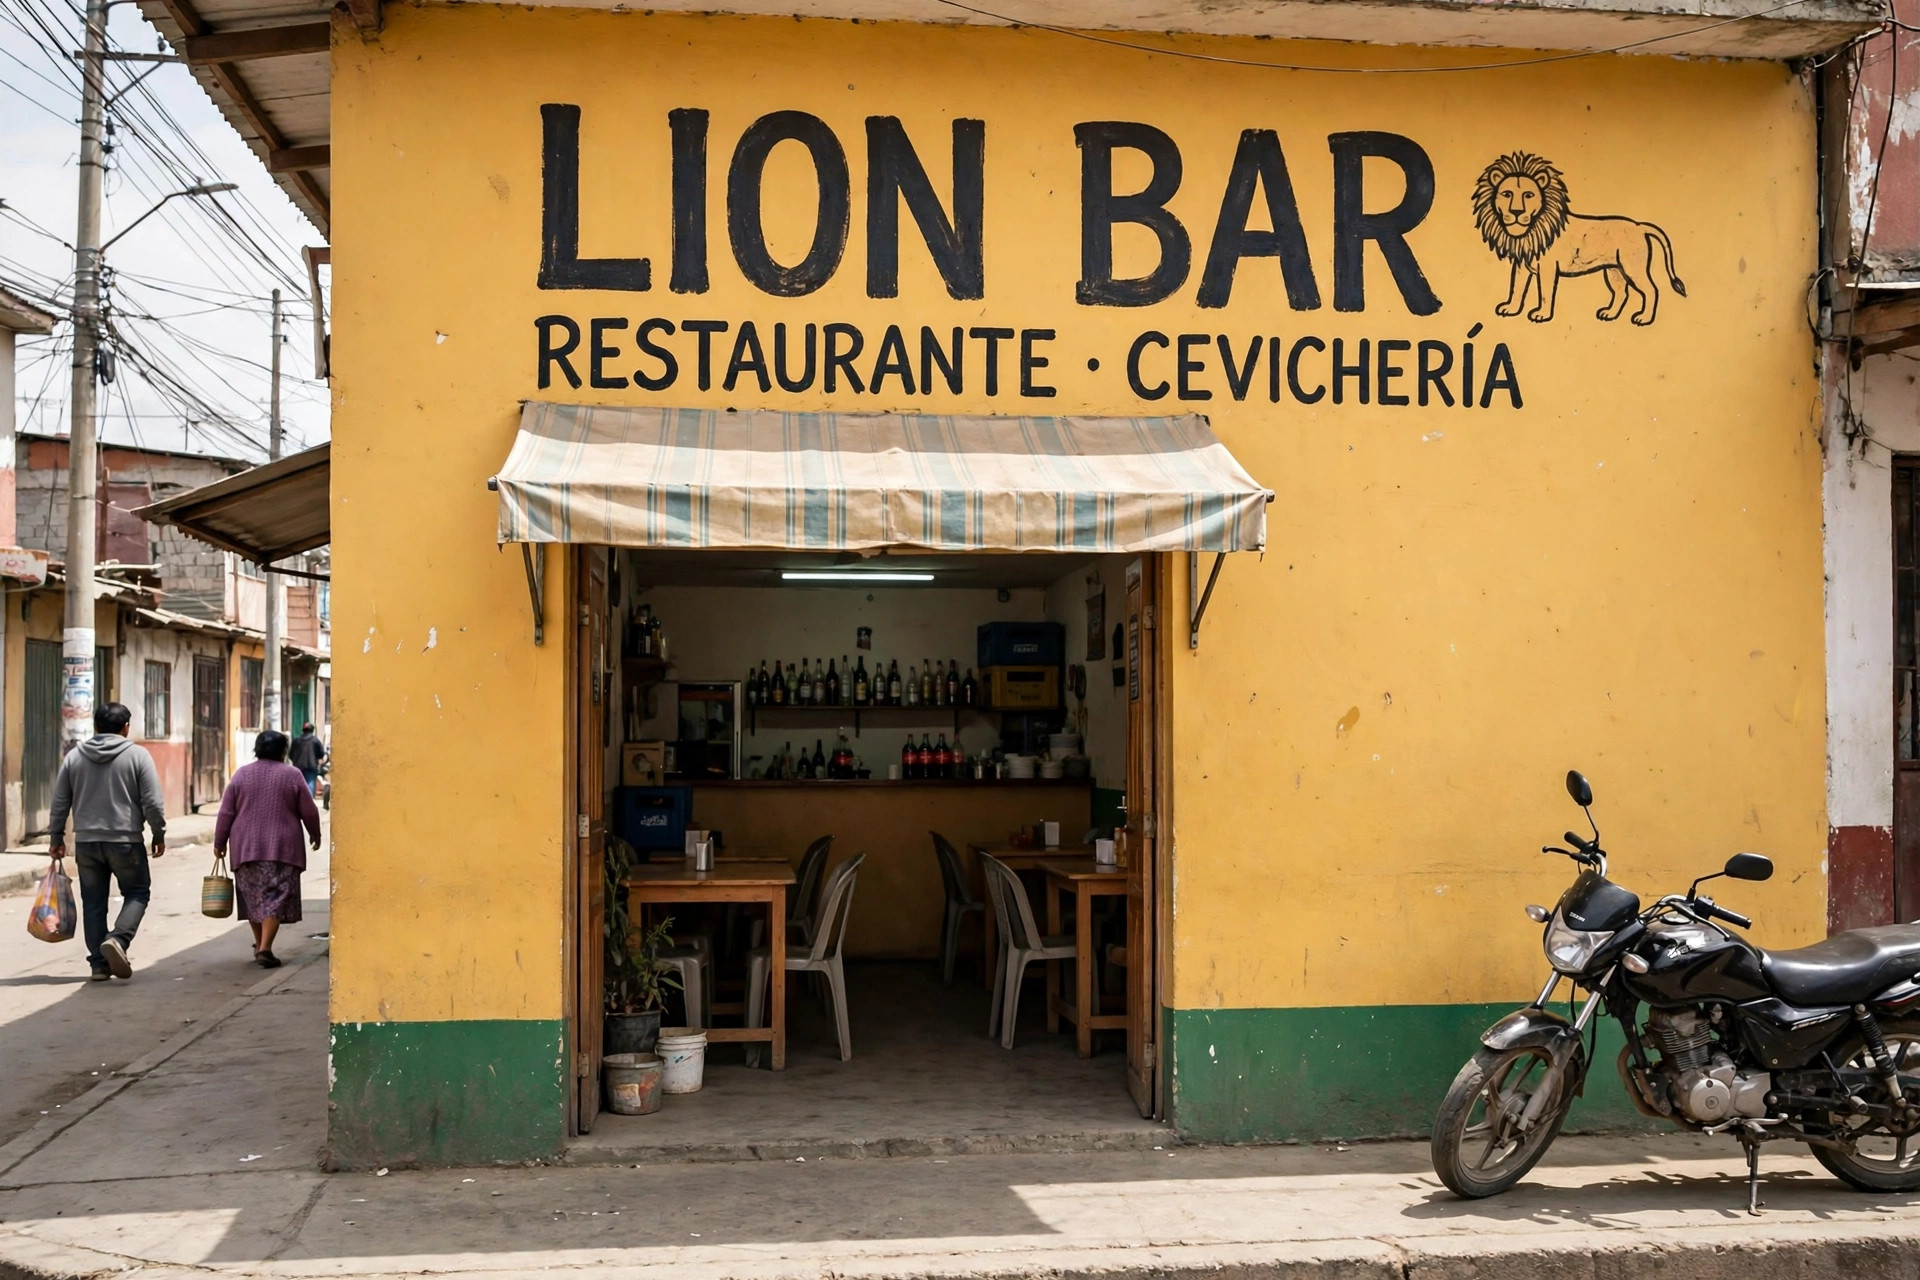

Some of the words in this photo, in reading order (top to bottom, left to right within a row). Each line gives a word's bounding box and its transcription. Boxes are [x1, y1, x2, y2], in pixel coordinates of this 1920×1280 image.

[537, 103, 985, 300] LION
[1073, 121, 1442, 316] BAR
[535, 315, 1056, 397] RESTAURANTE
[1127, 323, 1523, 409] CEVICHERÍA
